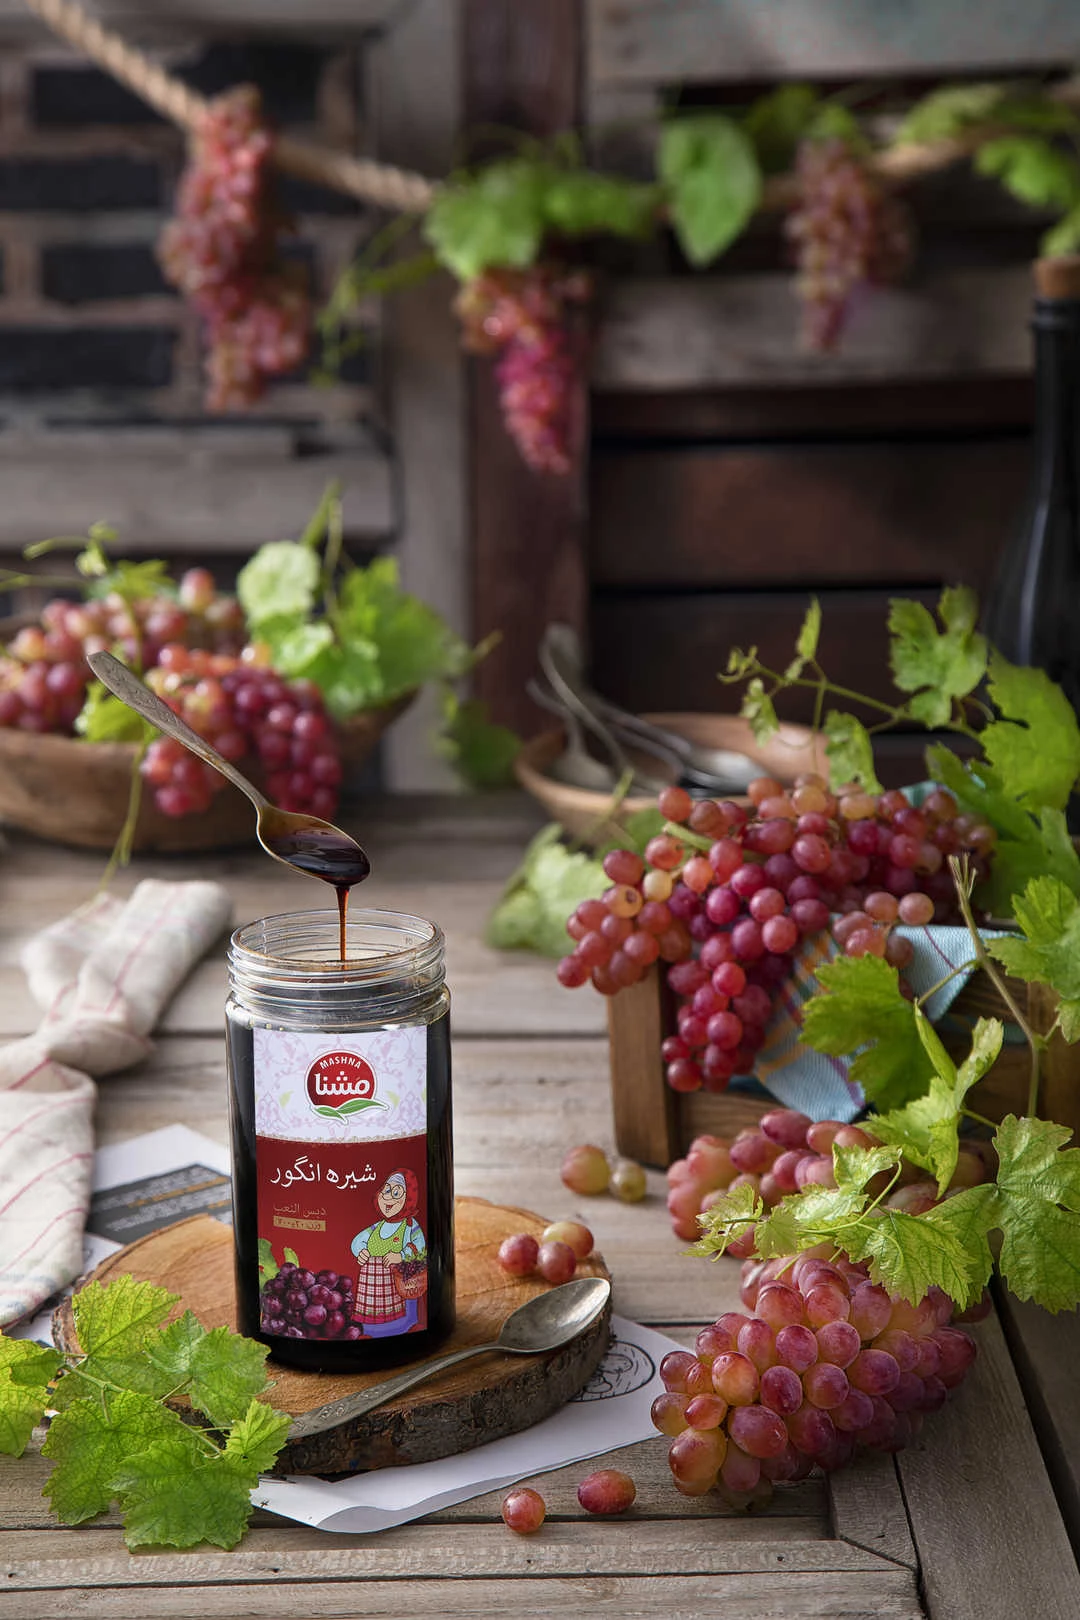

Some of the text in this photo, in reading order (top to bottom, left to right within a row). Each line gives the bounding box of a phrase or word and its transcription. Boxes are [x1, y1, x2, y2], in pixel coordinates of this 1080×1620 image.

[320, 1056, 361, 1069] MASHNA
[270, 1155, 376, 1189] شیره انگور
